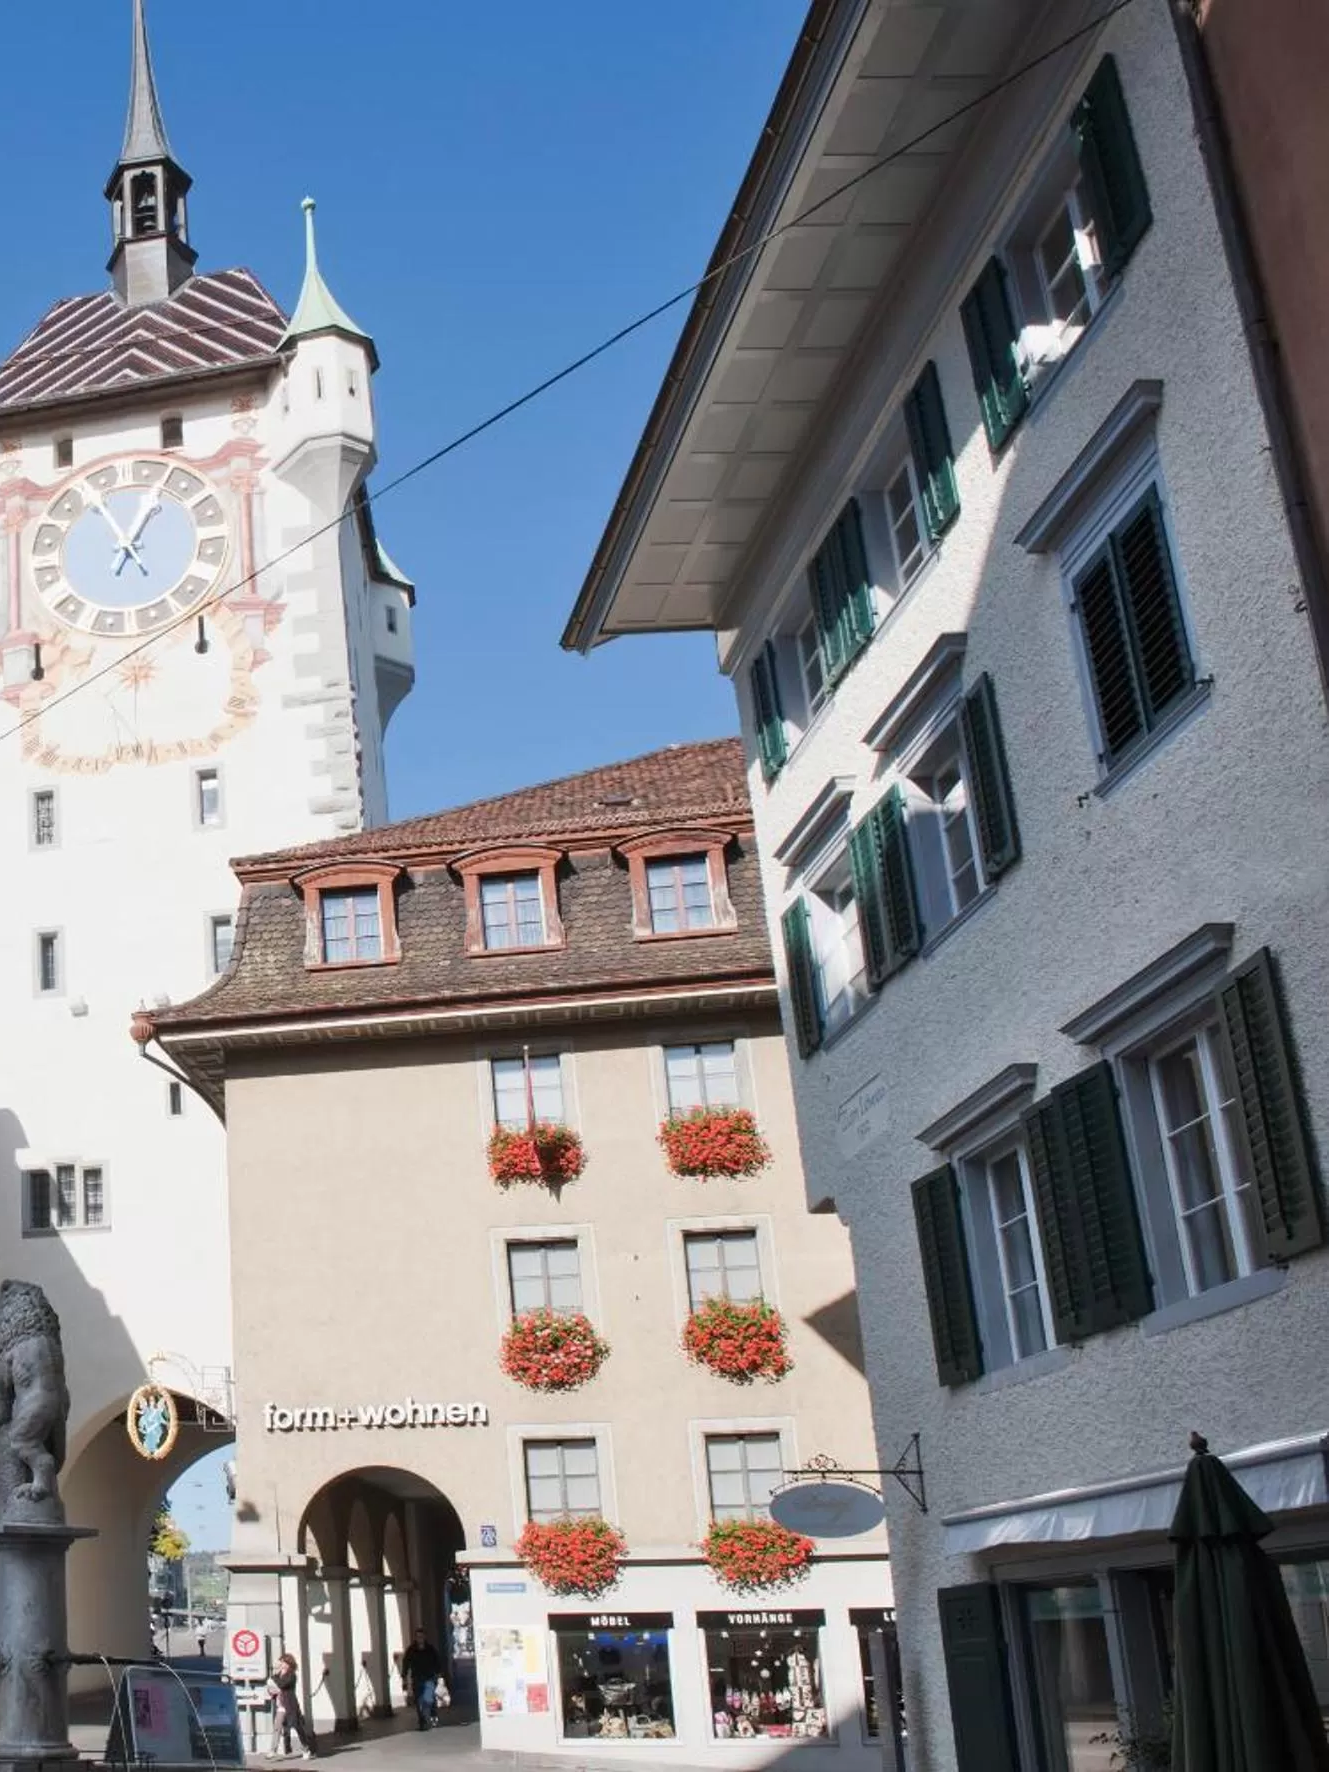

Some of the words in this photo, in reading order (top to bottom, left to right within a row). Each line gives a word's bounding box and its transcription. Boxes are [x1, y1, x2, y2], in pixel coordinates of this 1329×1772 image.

[265, 1397, 489, 1432] form+wohnen
[590, 1614, 632, 1627] MÖBEL
[727, 1612, 794, 1625] VORHÄNGE
